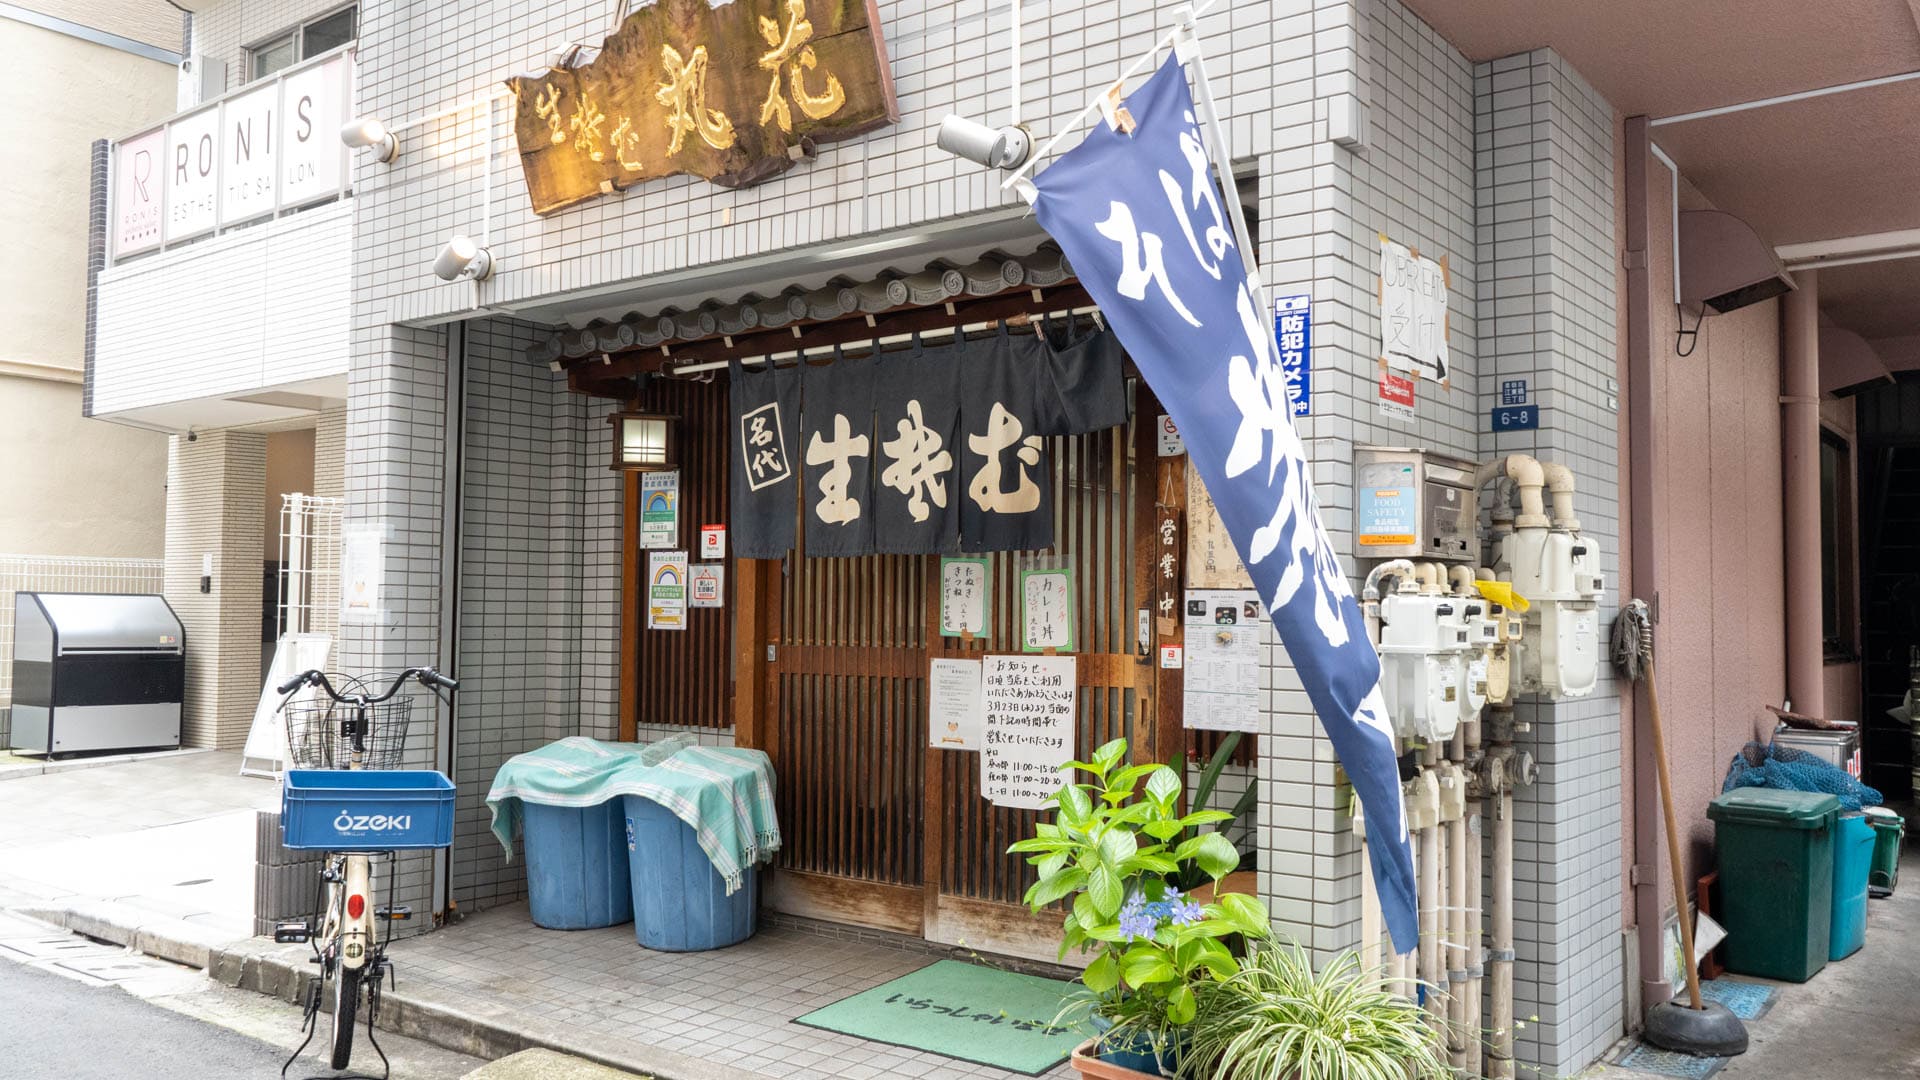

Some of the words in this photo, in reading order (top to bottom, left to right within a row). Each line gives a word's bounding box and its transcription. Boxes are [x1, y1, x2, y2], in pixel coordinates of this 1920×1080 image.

[175, 95, 313, 187] RONIS
[1389, 302, 1436, 350] 受付
[1280, 314, 1304, 401] 防犯カメラ
[1501, 410, 1529, 425] 6-8
[748, 415, 783, 479] 名代
[1367, 507, 1407, 517] SAFETY
[1374, 498, 1401, 507] FOOD
[953, 566, 962, 598] きつね
[965, 566, 975, 599] たぬき
[1159, 518, 1177, 619] 営業中
[1042, 577, 1057, 641] カレー丼
[996, 659, 1041, 674] お知らせ
